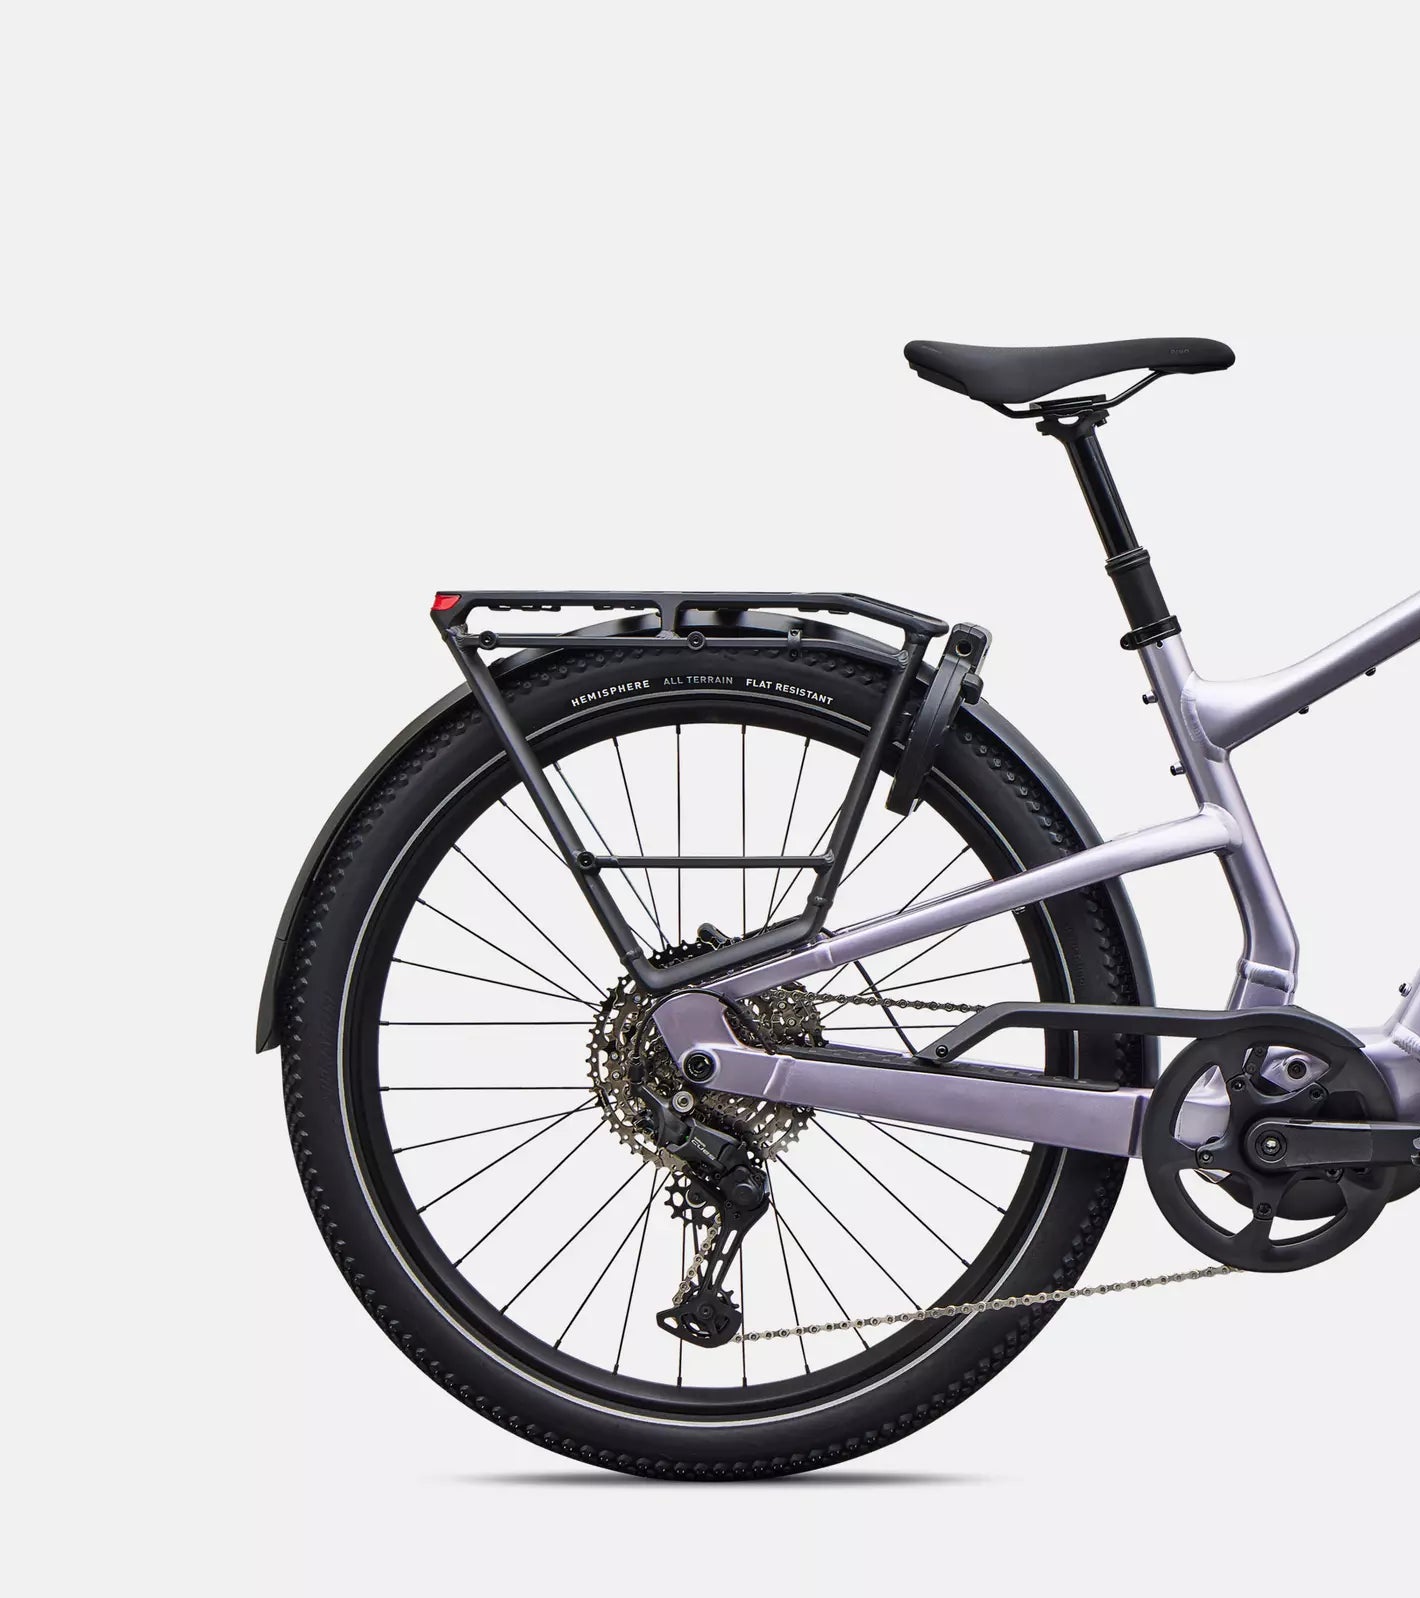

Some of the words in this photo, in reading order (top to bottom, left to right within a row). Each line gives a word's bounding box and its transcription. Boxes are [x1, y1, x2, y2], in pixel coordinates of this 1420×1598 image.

[570, 679, 650, 707] HEMISPHERE
[663, 676, 684, 686] ALL
[686, 675, 733, 685] TERRAIN
[745, 678, 773, 690] FLAT
[775, 682, 834, 705] RESISTANT
